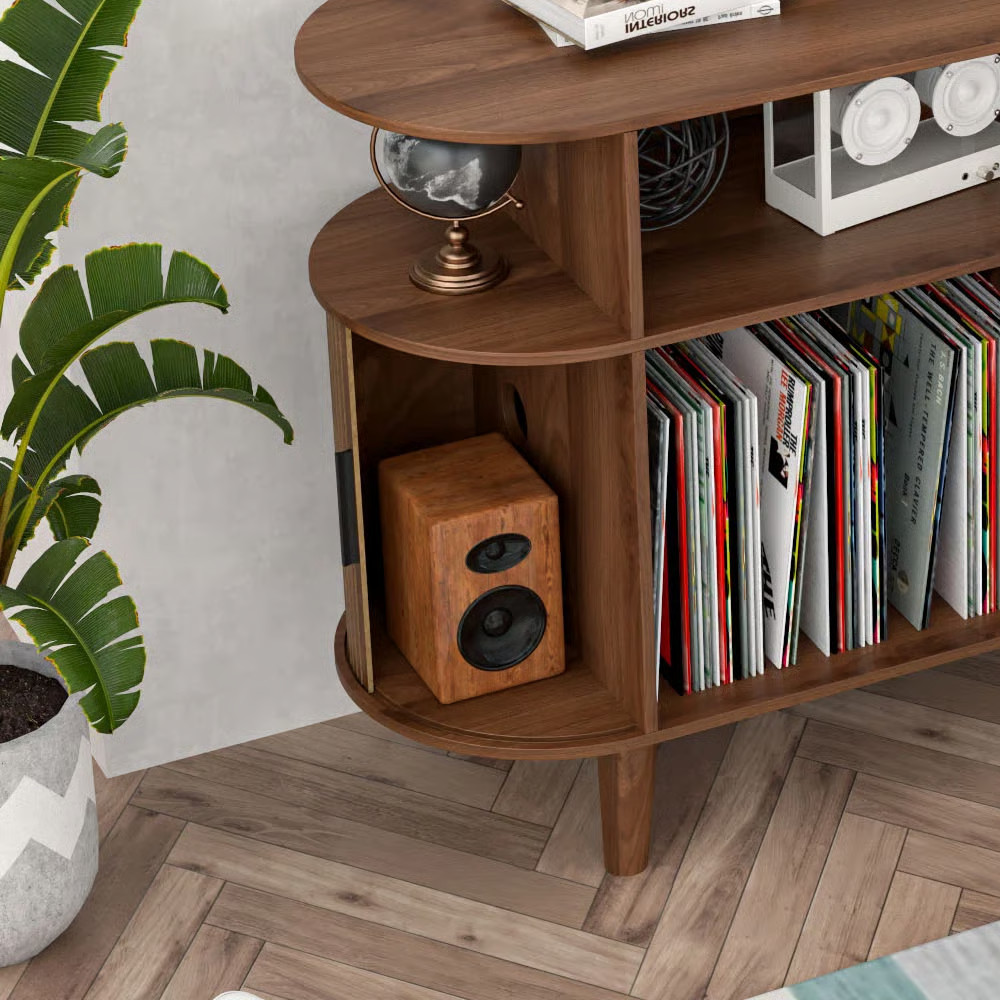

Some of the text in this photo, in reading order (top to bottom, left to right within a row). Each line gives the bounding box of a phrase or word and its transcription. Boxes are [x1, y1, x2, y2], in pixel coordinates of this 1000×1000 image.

[928, 344, 936, 366] THE
[776, 368, 789, 441] LEE MORGAN
[936, 373, 945, 405] BACH
[782, 375, 796, 449] RUMPROLLER
[789, 434, 798, 457] THE
[910, 476, 921, 525] CLAVIER
